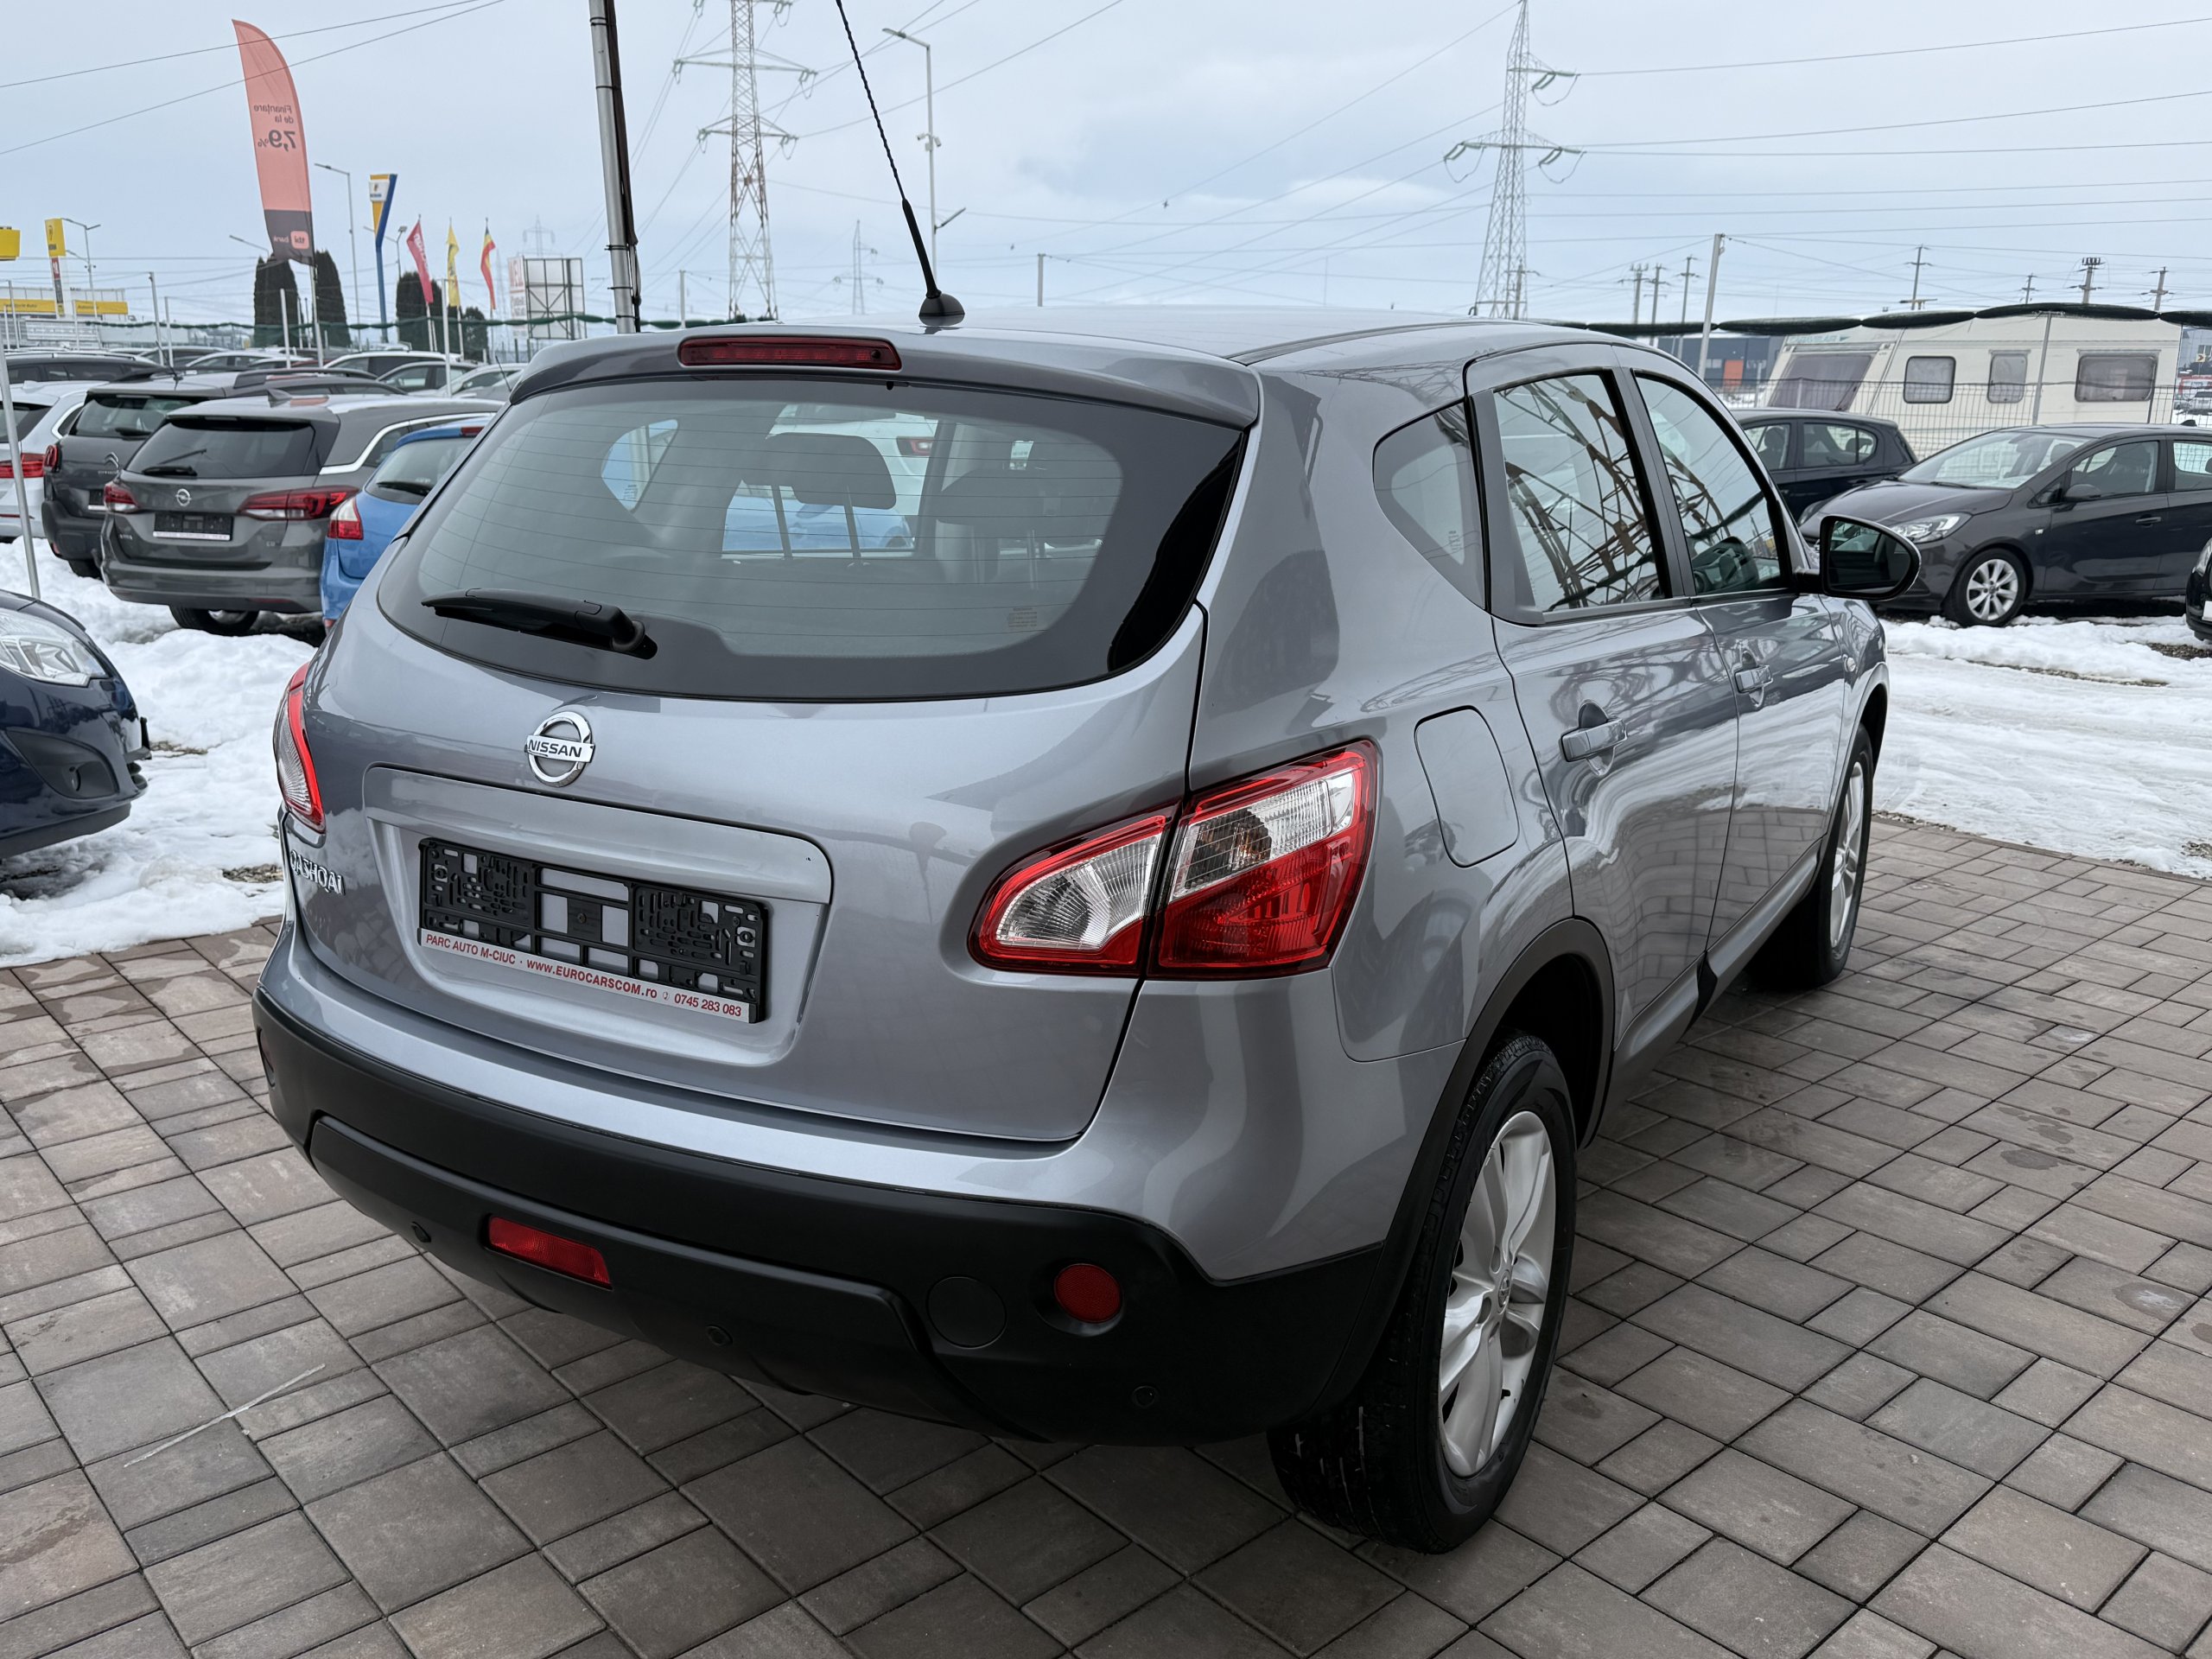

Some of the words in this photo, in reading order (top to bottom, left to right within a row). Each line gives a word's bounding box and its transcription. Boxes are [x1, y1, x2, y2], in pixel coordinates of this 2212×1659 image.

[528, 739, 582, 758] NISSAN
[289, 849, 346, 896] QASHQAI
[426, 933, 451, 949] PARC
[452, 942, 479, 956] AUTO
[480, 947, 516, 964] M-CIUC
[674, 993, 699, 1007] 0745
[701, 999, 720, 1013] 283
[722, 1003, 741, 1017] 083
